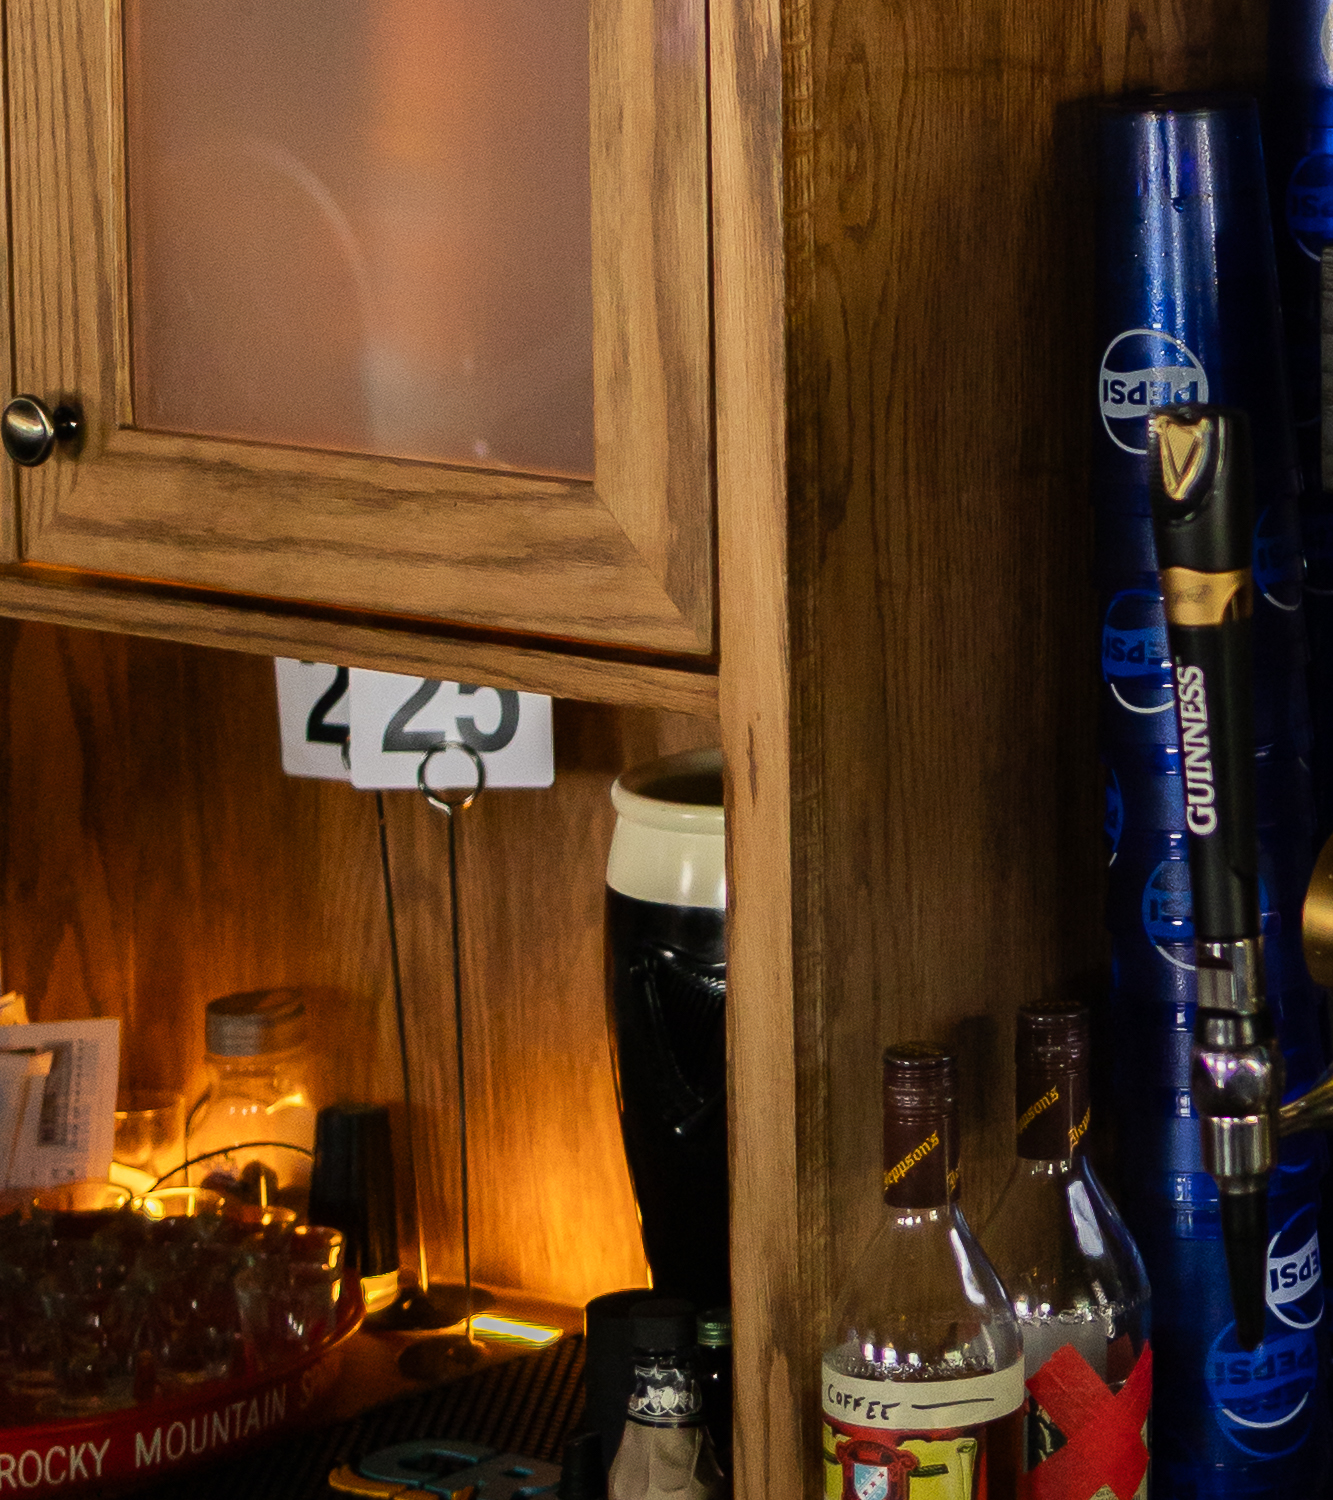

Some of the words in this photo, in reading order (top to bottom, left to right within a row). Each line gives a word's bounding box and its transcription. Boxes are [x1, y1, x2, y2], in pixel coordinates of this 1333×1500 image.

[1102, 380, 1200, 405] PEPSI
[1179, 664, 1218, 837] GUINNESS
[0, 1438, 110, 1489] ROCKY
[135, 1383, 286, 1469] MOUNTAIN
[827, 1383, 900, 1421] COFFEE
